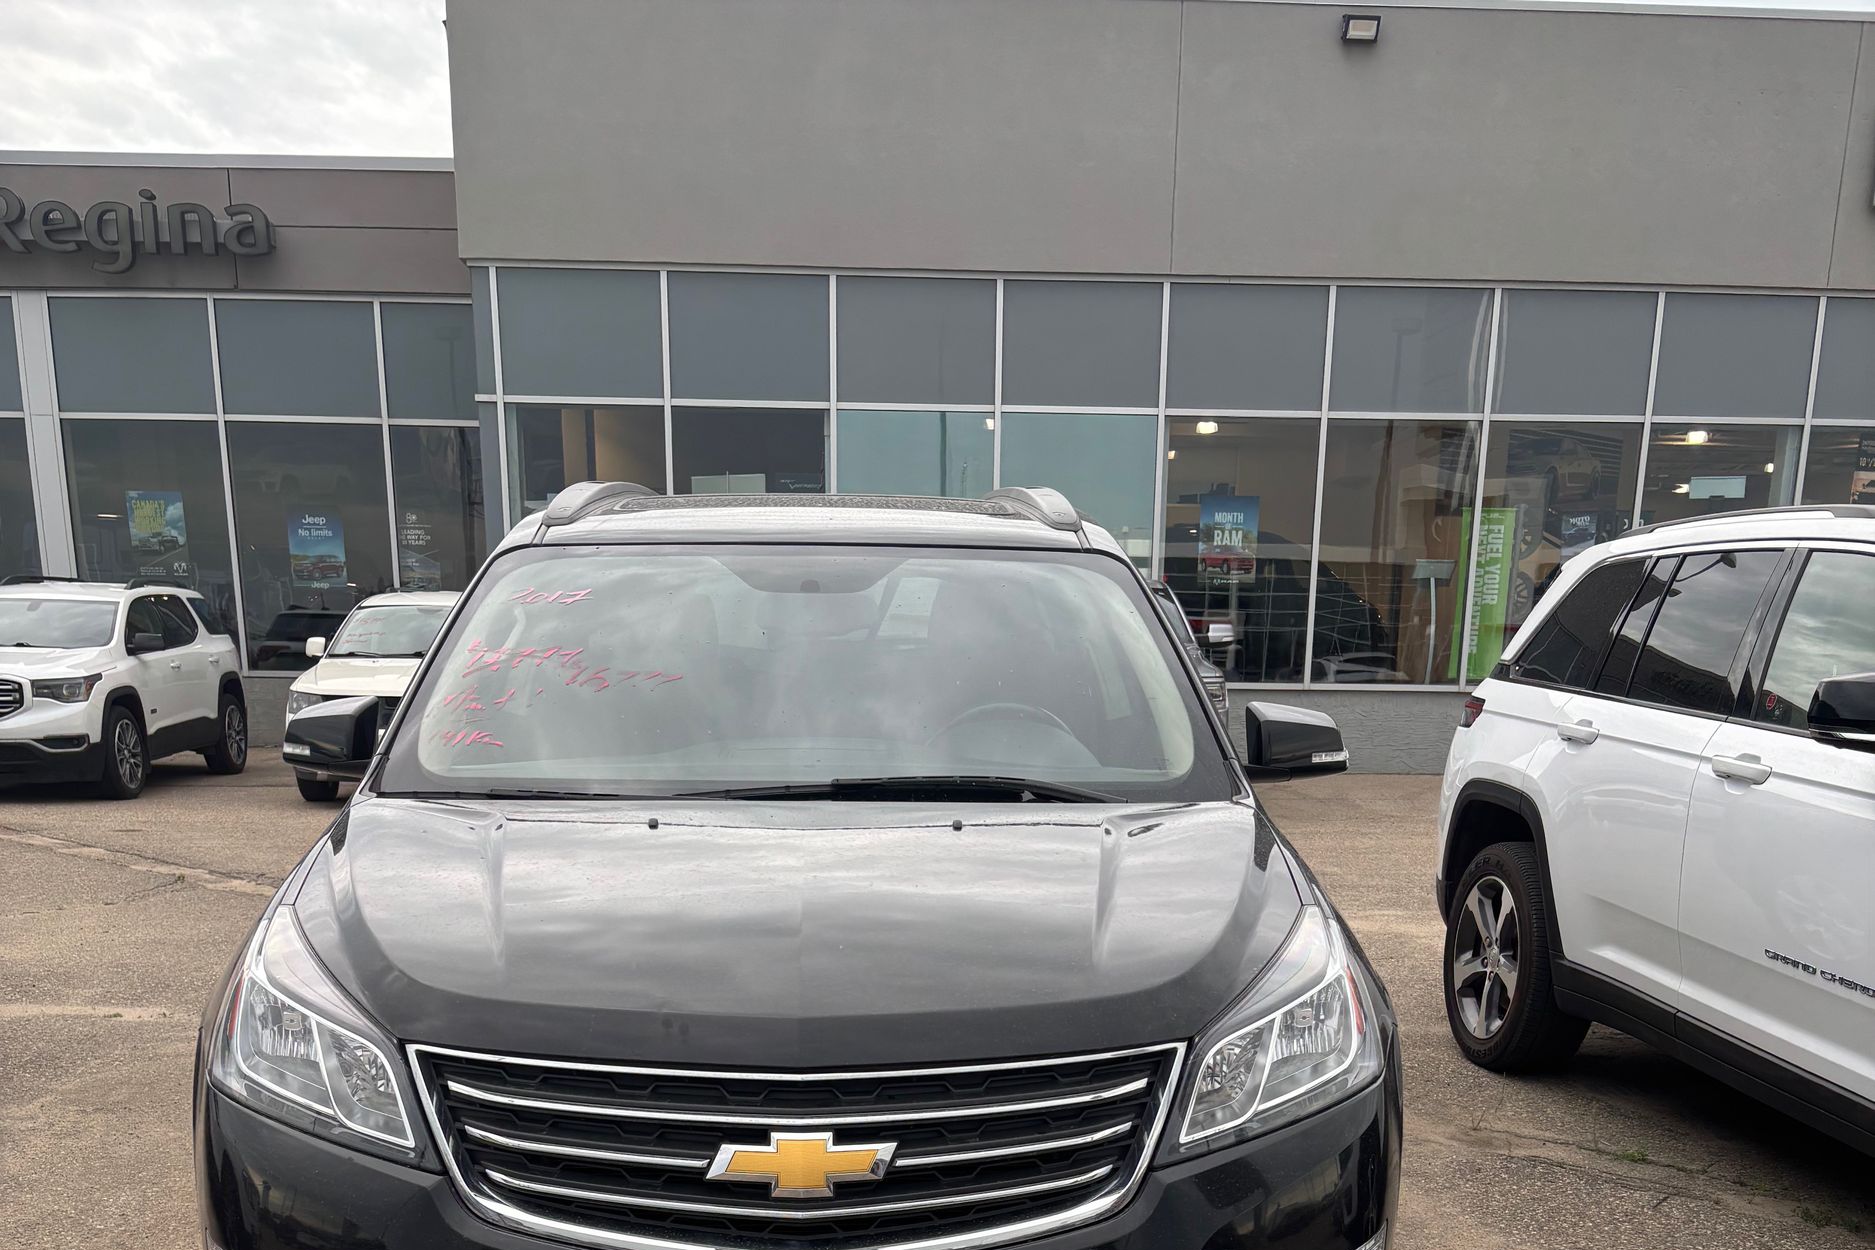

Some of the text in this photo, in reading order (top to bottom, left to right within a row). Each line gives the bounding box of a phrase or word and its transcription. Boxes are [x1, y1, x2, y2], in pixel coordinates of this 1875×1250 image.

[0, 187, 273, 273] Regina
[302, 514, 326, 525] Jeep
[1214, 512, 1244, 523] MONTH
[298, 528, 333, 537] No limits
[1213, 530, 1243, 547] RAM
[1485, 525, 1505, 561] FUEL
[311, 581, 330, 589] Jeep
[1481, 564, 1501, 605] YOUR
[1764, 948, 1817, 975] GRAND
